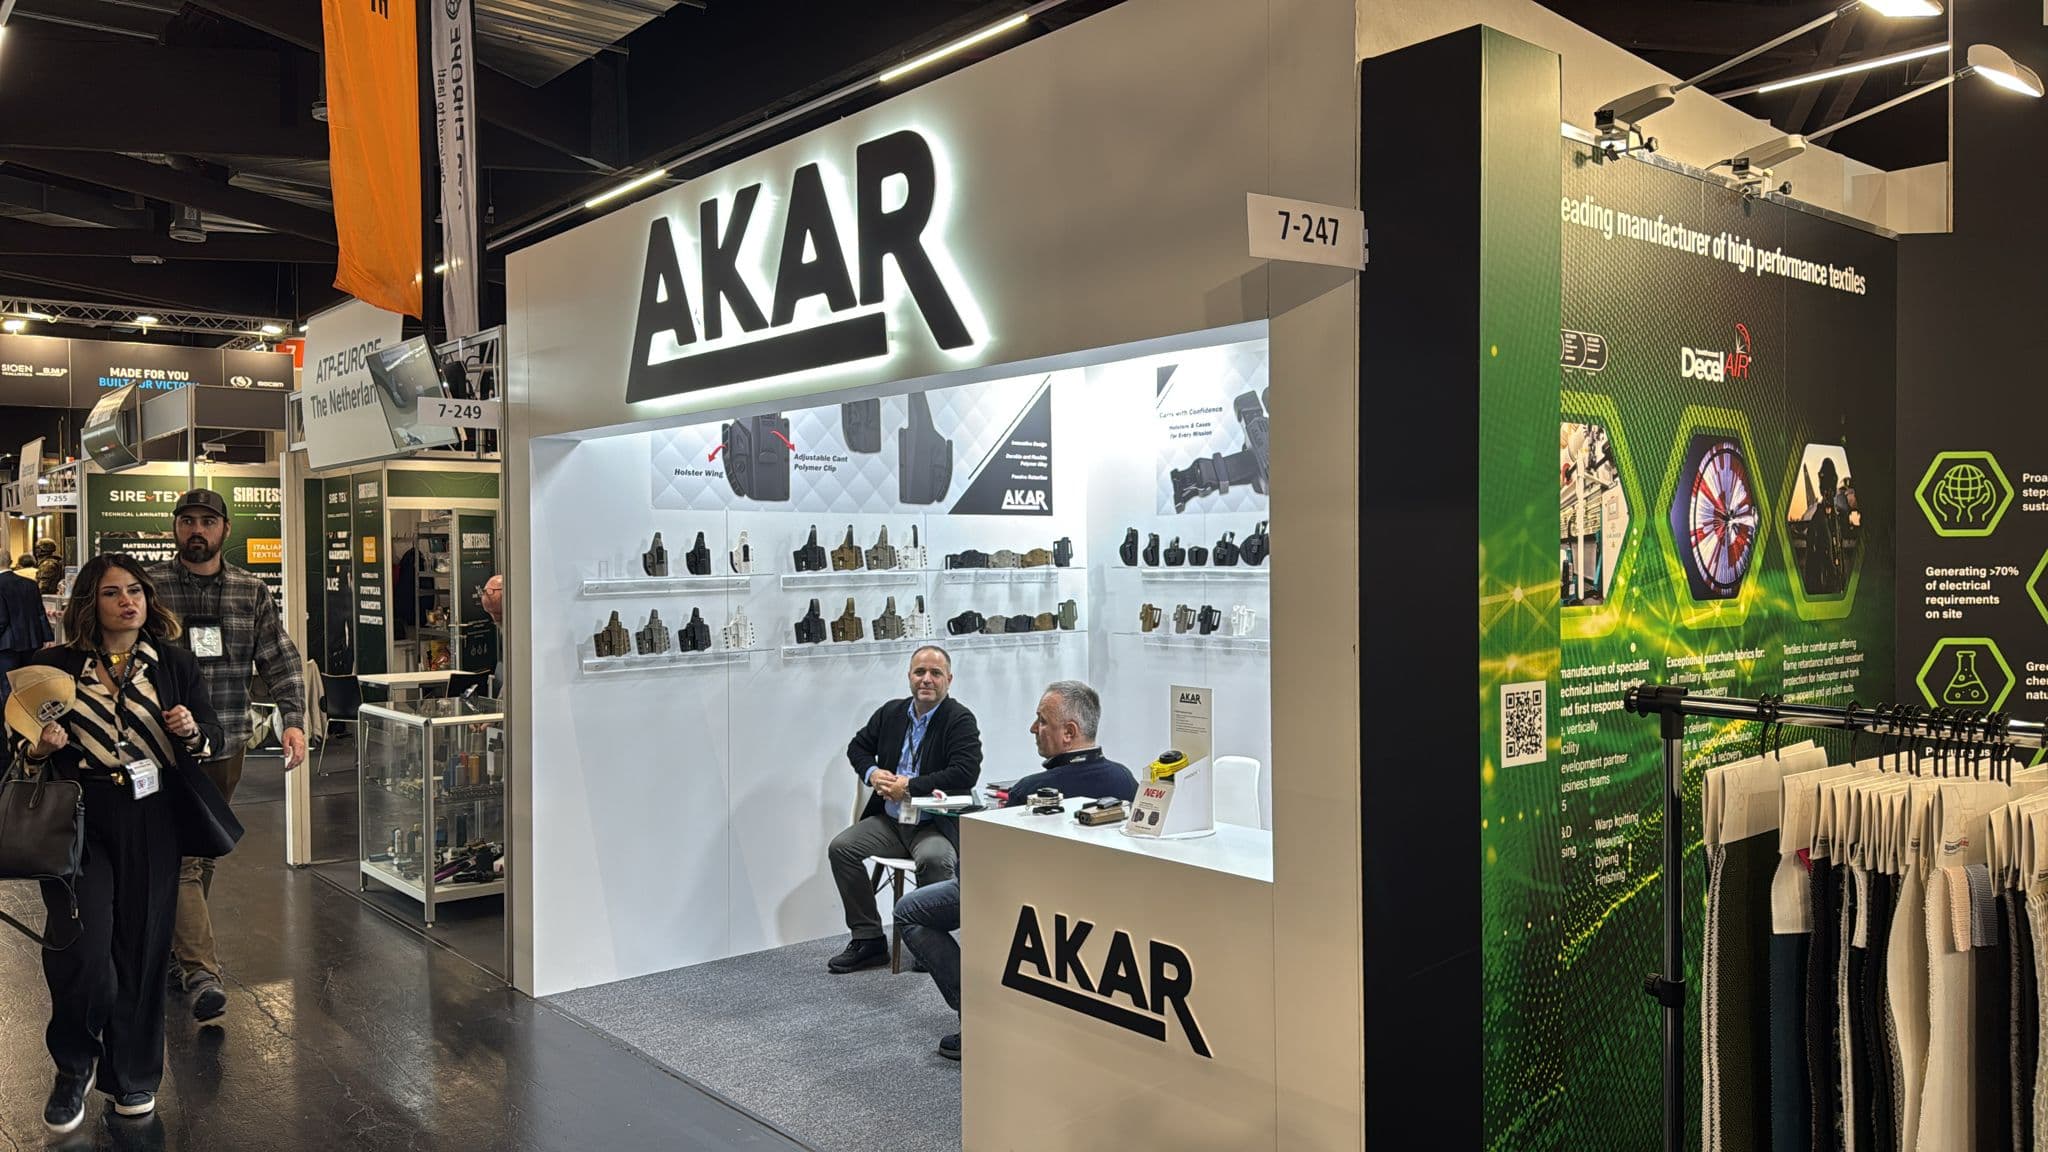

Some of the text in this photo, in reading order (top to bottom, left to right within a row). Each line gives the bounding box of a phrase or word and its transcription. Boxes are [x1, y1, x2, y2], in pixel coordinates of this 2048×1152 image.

[1278, 210, 1339, 246] 7-247
[1561, 195, 1866, 296] eading manufacturer of high performance textiles
[625, 129, 974, 403] AKAR
[1, 363, 33, 373] SIOEN
[109, 367, 189, 381] MADE FOR YOU
[98, 377, 129, 387] BUILT
[310, 393, 328, 420] The
[438, 403, 481, 419] 7-249
[1189, 406, 1223, 416] Confidence
[794, 453, 831, 462] Adjustable
[674, 468, 724, 479] Holster Wing
[794, 464, 822, 472] Polymer
[110, 490, 147, 502] SIRE
[1001, 489, 1049, 511] AKAR
[1925, 566, 2020, 578] Generating >70%
[1925, 580, 1991, 590] of electrical
[1925, 594, 2000, 607] requirements
[1925, 608, 1963, 619] on site
[1809, 641, 1827, 652] combat
[1666, 647, 1765, 669] Exceptional parachute fabrics for:
[1824, 655, 1833, 666] and
[1834, 655, 1844, 665] heat
[1560, 658, 1650, 679] manufacture of specialist
[1670, 668, 1736, 685] all military applications
[1783, 674, 1808, 689] protection
[1816, 671, 1839, 683] helicopter
[1839, 668, 1849, 679] and
[1560, 682, 1592, 698] echnical
[1594, 679, 1619, 693] knitted
[1179, 692, 1202, 704] AKAR
[1574, 702, 1590, 714] first
[1591, 699, 1625, 714] response
[1566, 719, 1598, 735] vertically
[1688, 721, 1712, 734] delivery
[1561, 753, 1628, 774] evelopment partner
[1561, 775, 1611, 793] usiness teams
[1143, 787, 1166, 800] NEW
[1595, 811, 1639, 831] Warp knitting
[1595, 835, 1624, 849] Weaving
[1561, 844, 1577, 859] sing
[1595, 851, 1619, 872] Dyeing
[1595, 869, 1626, 887] Finishing
[1001, 904, 1213, 1059] AKAR
